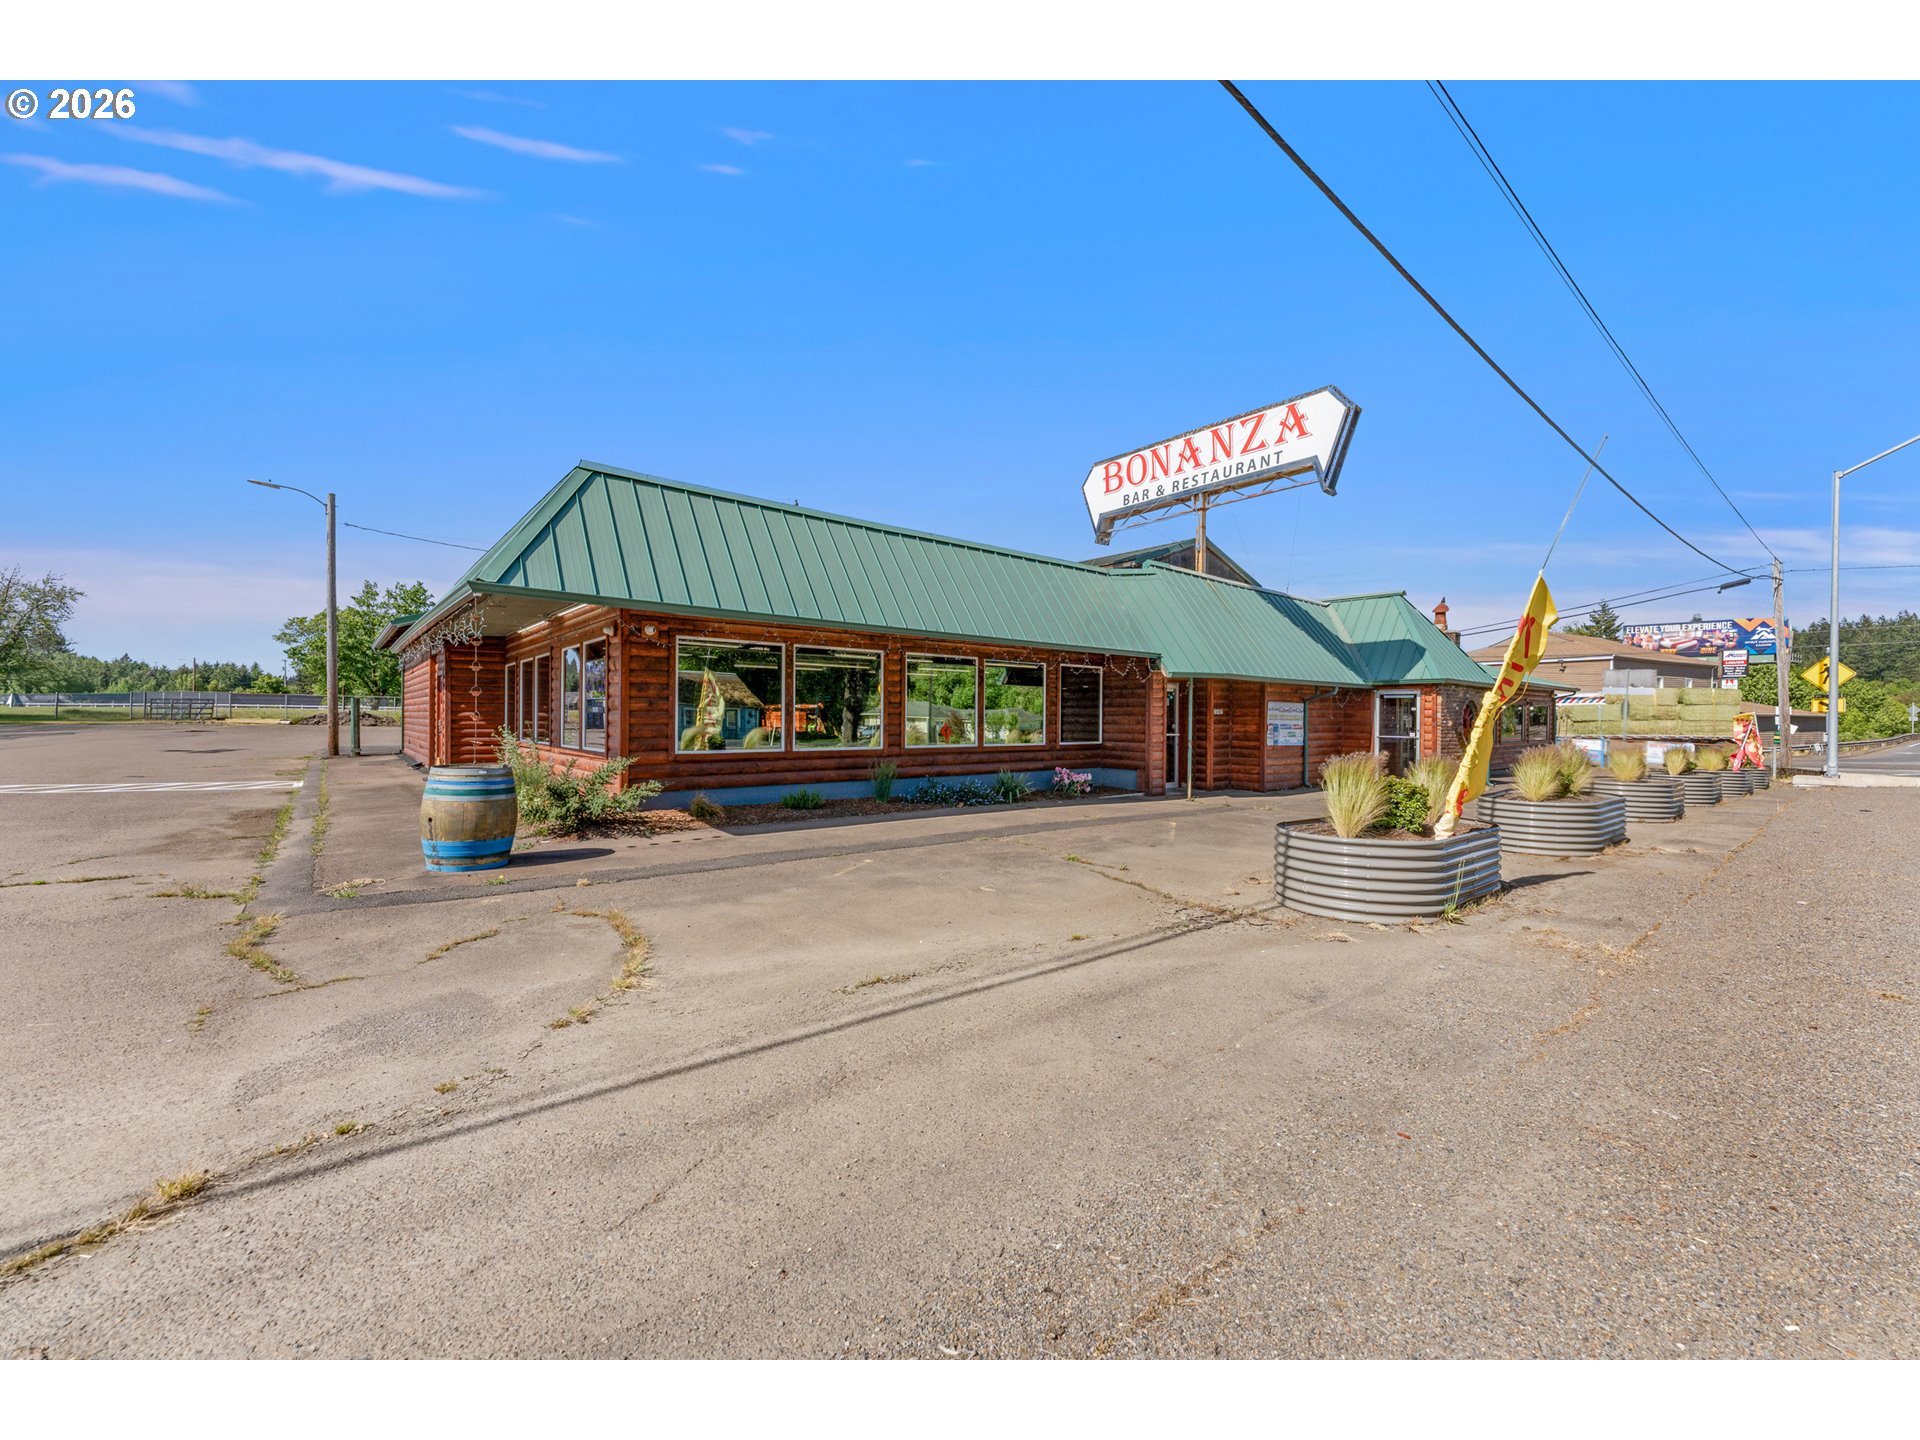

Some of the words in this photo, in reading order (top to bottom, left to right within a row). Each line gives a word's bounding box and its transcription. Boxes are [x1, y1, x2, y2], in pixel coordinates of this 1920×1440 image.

[1102, 401, 1313, 496] BONANZA
[1122, 486, 1150, 506] BAR
[1156, 484, 1165, 497] &
[1171, 450, 1284, 493] RESTAURANT
[1626, 625, 1660, 634] ELEVATE
[1660, 624, 1681, 632] YOUR
[1682, 621, 1733, 631] EXPERIENCE
